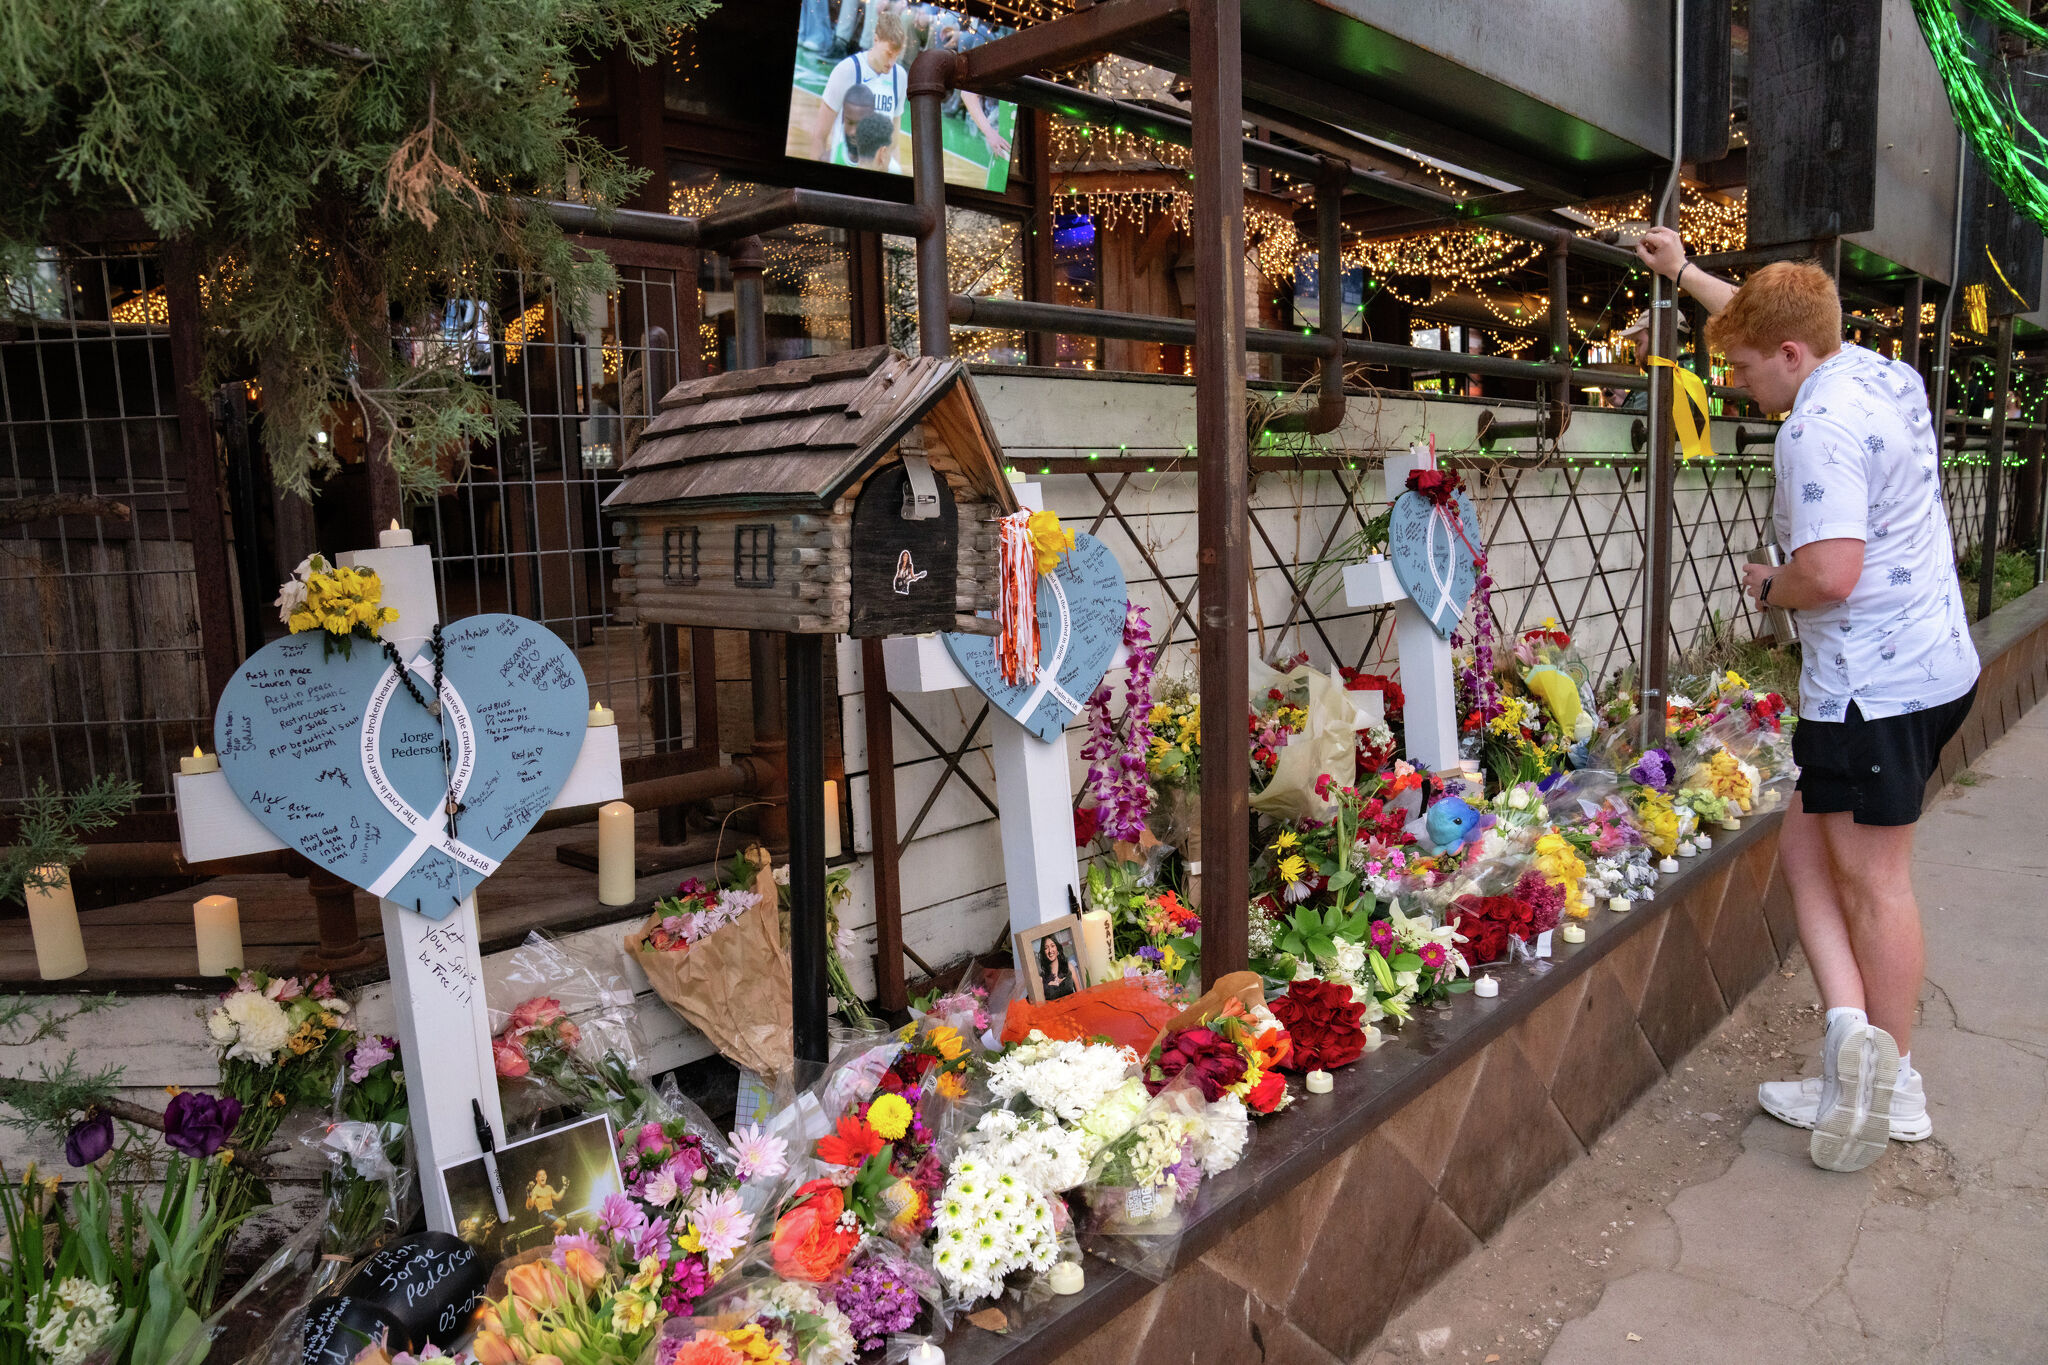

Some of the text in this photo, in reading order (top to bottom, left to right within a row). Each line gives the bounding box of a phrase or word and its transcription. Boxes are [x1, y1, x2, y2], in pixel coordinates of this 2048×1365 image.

[246, 669, 269, 681] Rest
[273, 669, 285, 677] in
[444, 691, 461, 715] saves
[456, 714, 467, 730] the
[365, 668, 419, 826] The Lord is near to the brokenhearted
[400, 731, 434, 744] Jorge
[269, 744, 287, 759] RIP
[462, 730, 473, 768] crushed
[459, 767, 469, 779] in
[442, 839, 490, 871] Psalm 34:18
[439, 922, 465, 944] Let
[418, 950, 431, 967] be
[447, 955, 478, 986] Spirit
[380, 1247, 446, 1292] Jorge
